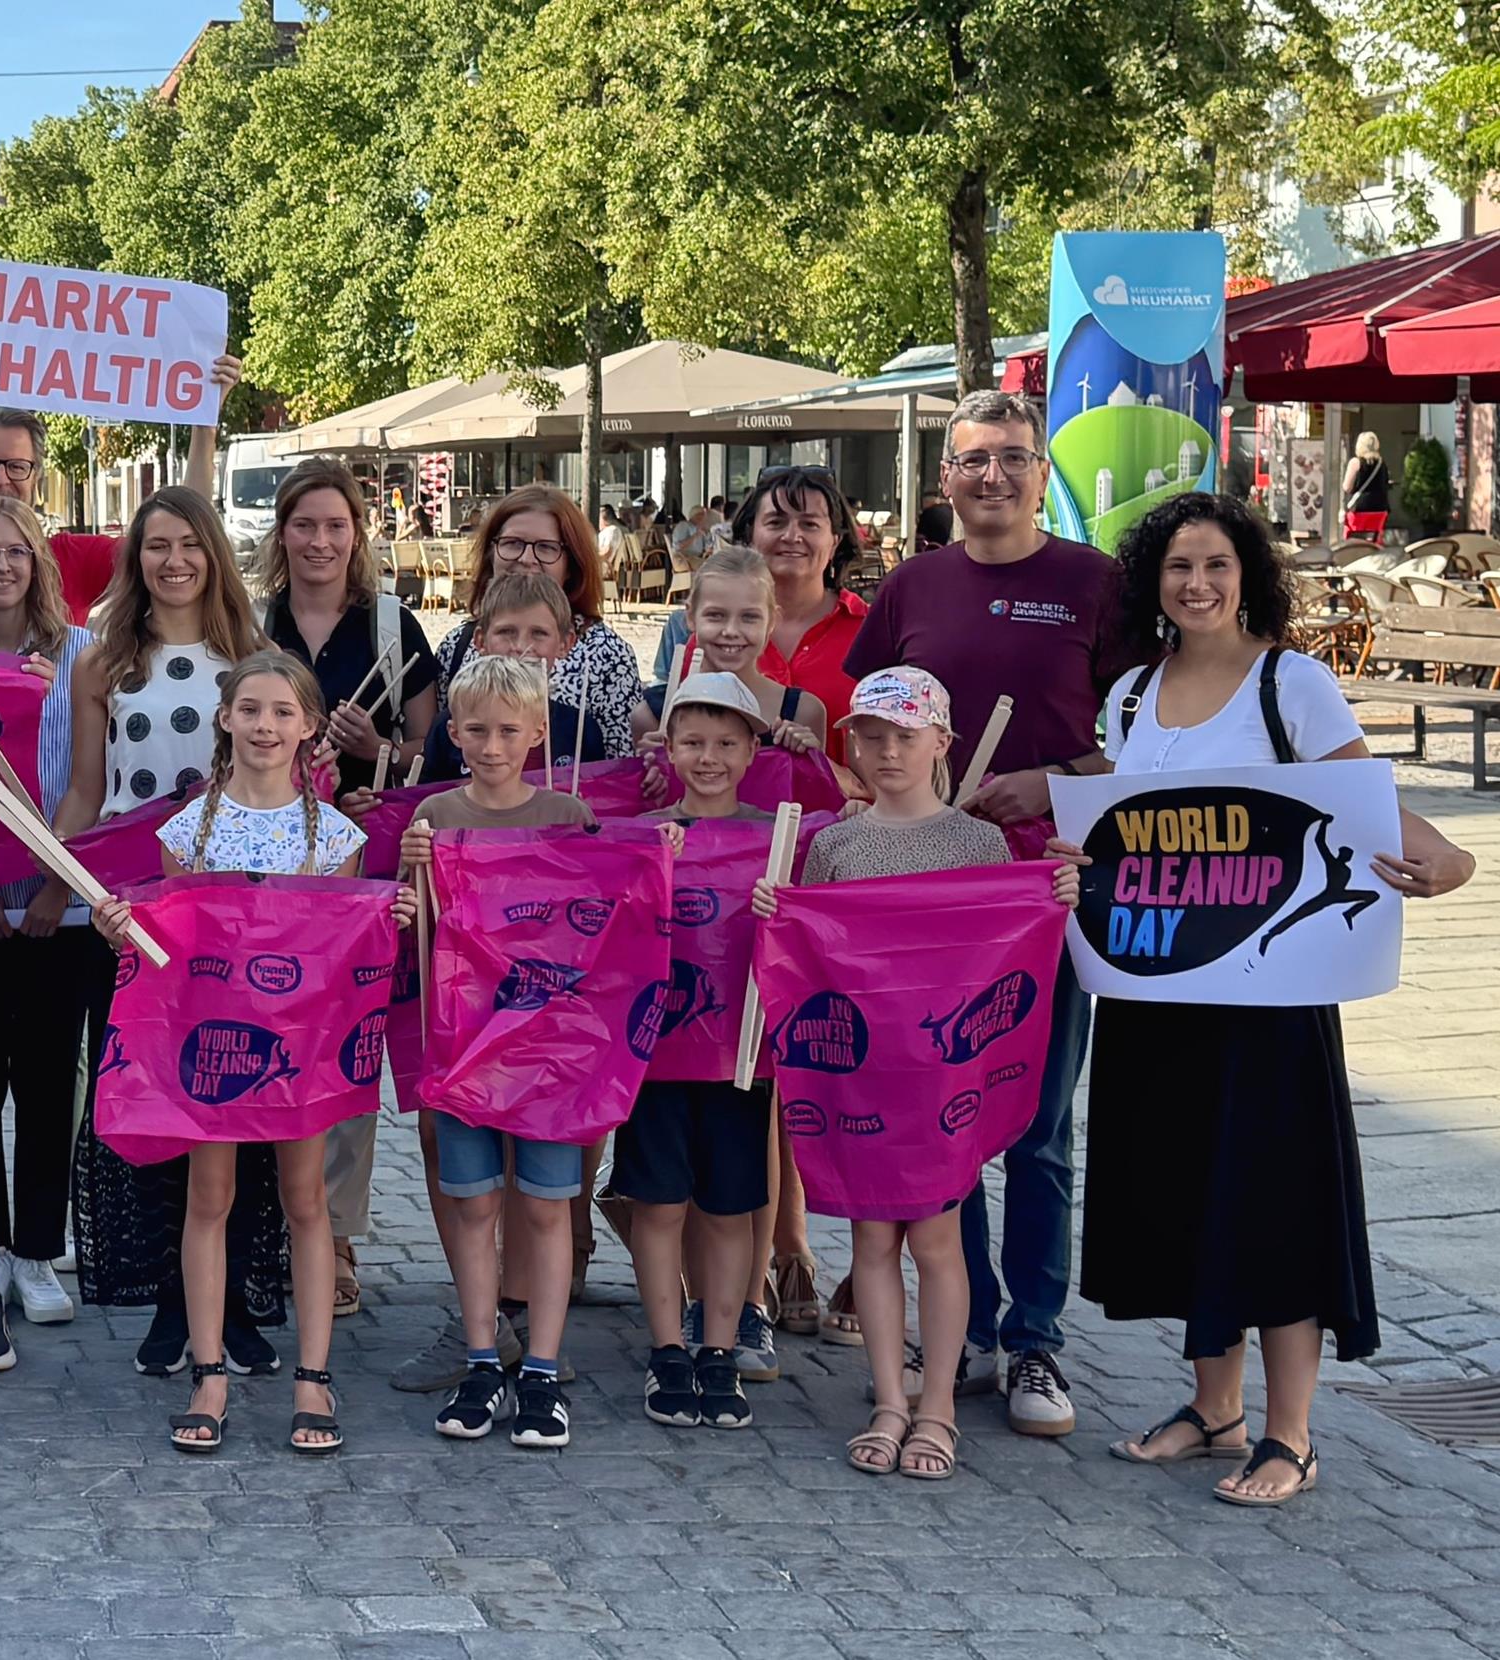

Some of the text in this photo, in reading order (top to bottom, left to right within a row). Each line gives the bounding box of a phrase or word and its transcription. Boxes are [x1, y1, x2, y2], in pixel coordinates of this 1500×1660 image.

[1130, 294, 1213, 306] NEUMARKT
[744, 415, 792, 428] LORENZO
[1011, 608, 1077, 623] GRUNDSCHULE
[1114, 804, 1250, 853] WORLD
[1113, 855, 1284, 906] CLEANUP
[1107, 906, 1186, 957] DAY
[192, 959, 230, 977] swirl
[255, 962, 295, 979] handy
[261, 973, 286, 988] bag
[993, 972, 1023, 1002] DAY
[827, 996, 853, 1022] DAY
[959, 992, 1020, 1039] CLEANUP
[198, 1026, 251, 1052] WORLD
[793, 1017, 855, 1045] CLEANUP
[970, 1011, 1014, 1051] WORLD
[195, 1050, 263, 1076] CLEANUP
[808, 1040, 857, 1068] WORLD
[191, 1072, 222, 1097] DAY
[838, 1115, 881, 1133] swirl
